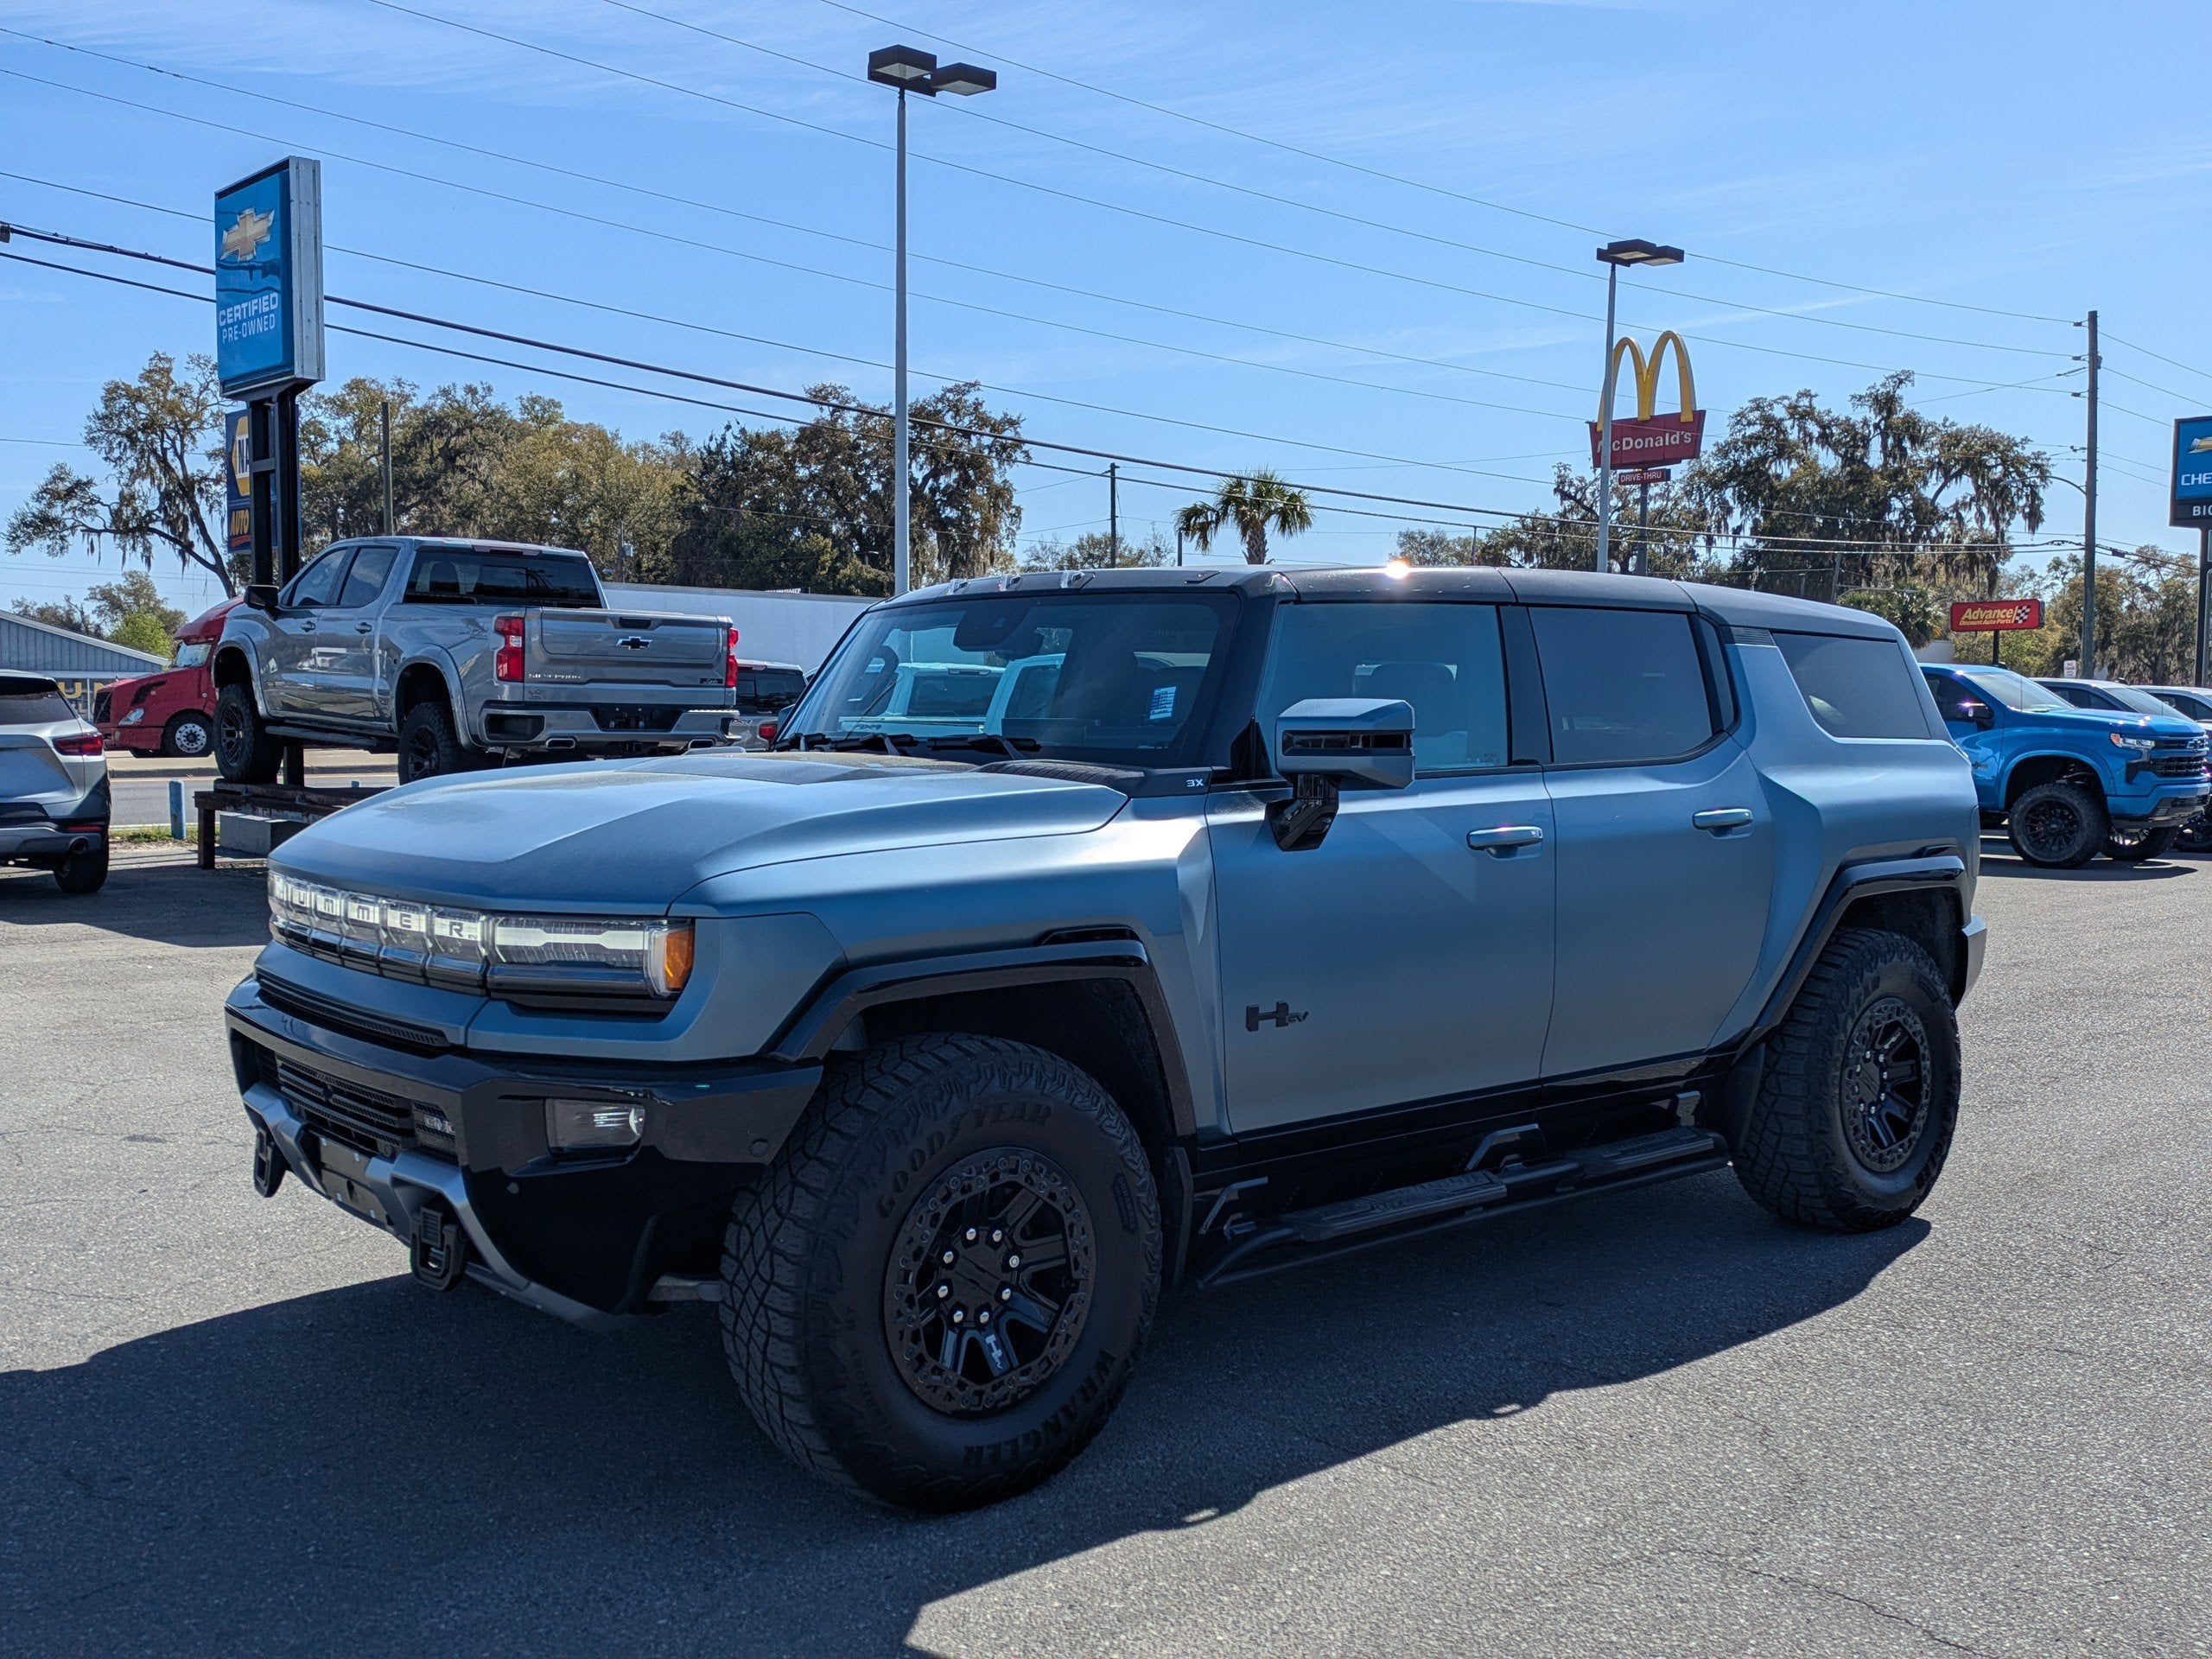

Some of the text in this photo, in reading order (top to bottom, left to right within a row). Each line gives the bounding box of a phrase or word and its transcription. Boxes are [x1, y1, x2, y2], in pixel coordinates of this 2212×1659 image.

[219, 292, 278, 327] CERTIFIED
[222, 313, 276, 344] PRE-OWNED
[1620, 470, 1662, 483] DRIVE-THRU
[230, 508, 250, 536] AUTO
[1961, 607, 2014, 620] Advance
[1185, 779, 1205, 787] 3X
[290, 887, 464, 938] UMMER
